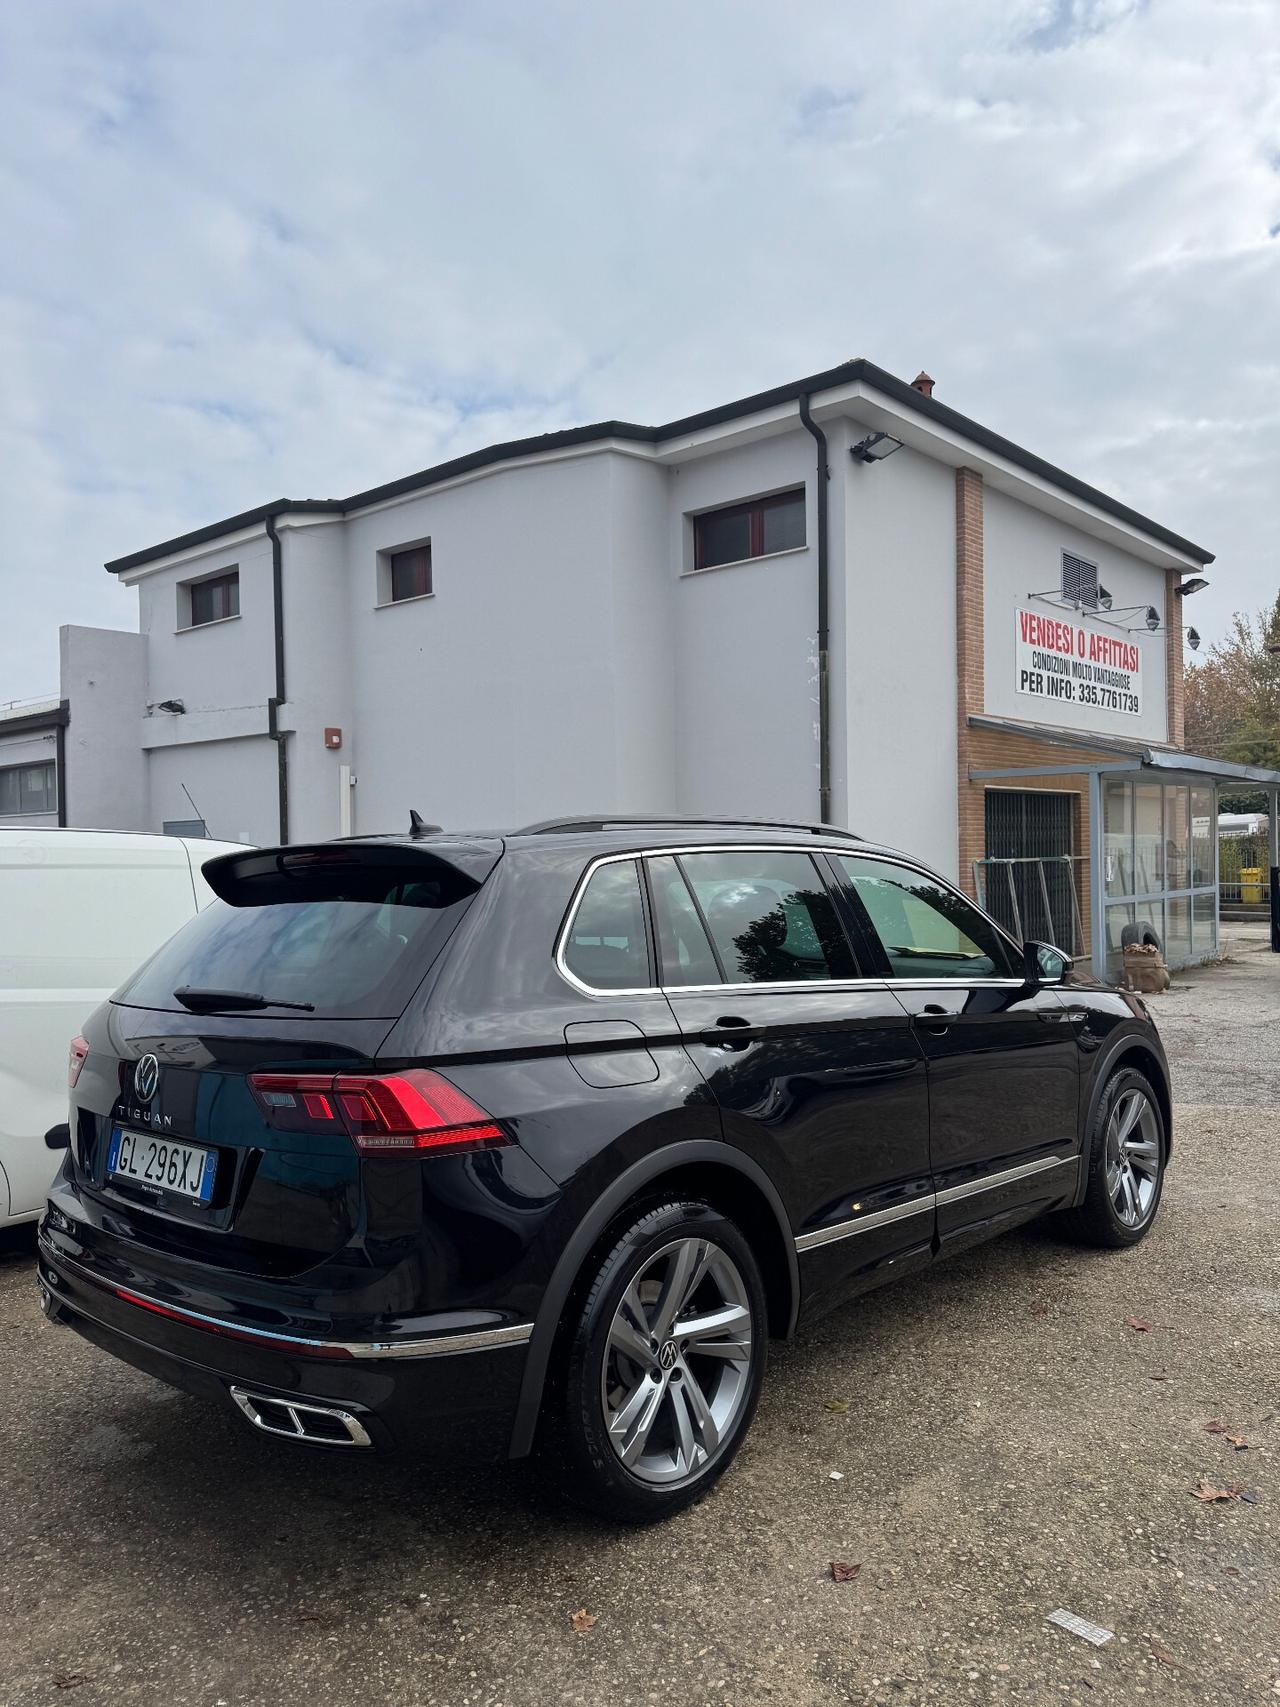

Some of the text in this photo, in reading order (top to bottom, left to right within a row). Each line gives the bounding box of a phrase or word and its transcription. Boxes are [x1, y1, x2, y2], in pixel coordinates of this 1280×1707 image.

[1020, 611, 1139, 673] VENDESI O AFFITTASI
[1020, 669, 1139, 713] PER INFO: 335.7761739
[1032, 650, 1131, 691] CONDIZIONI MOLTO VANTAGGIOSE
[118, 1105, 172, 1126] TIGUAN
